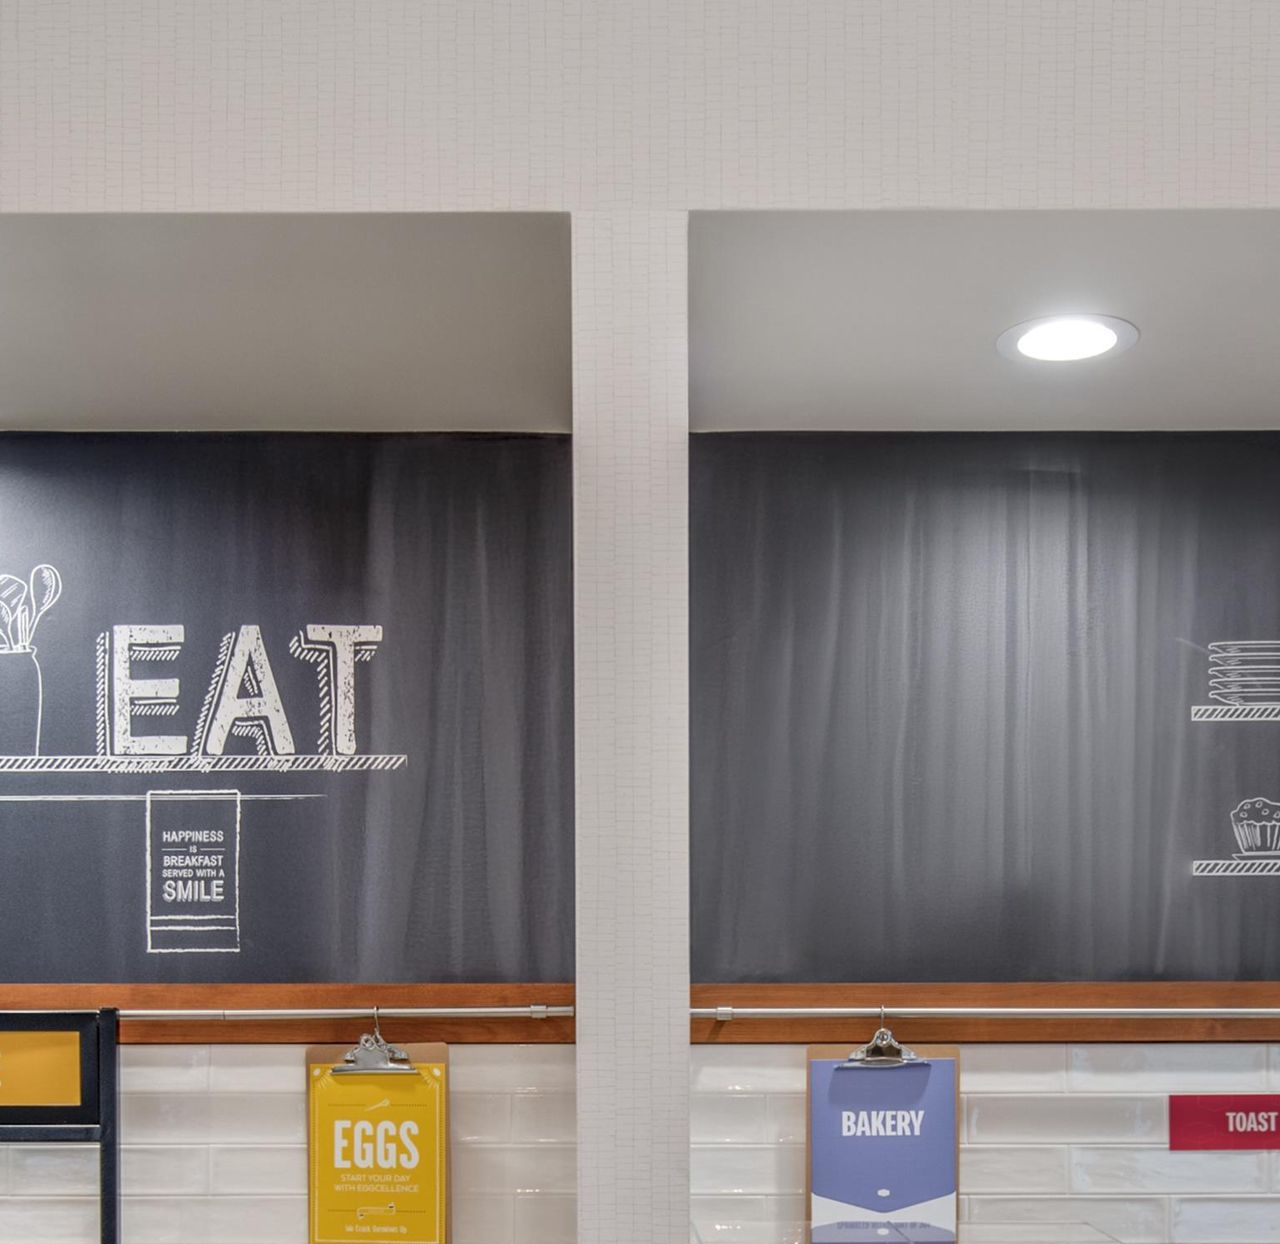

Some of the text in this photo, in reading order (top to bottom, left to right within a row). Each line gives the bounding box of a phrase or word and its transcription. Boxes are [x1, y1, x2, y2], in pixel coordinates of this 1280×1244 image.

[97, 625, 383, 757] EAT
[162, 831, 224, 842] HAPPINESS
[189, 845, 197, 853] IS
[163, 855, 223, 867] BREAKFAST
[162, 869, 225, 877] SERVED WITH A
[162, 880, 224, 902] SMILE
[841, 1110, 924, 1137] BAKERY
[1226, 1112, 1278, 1132] TOAST
[333, 1120, 420, 1169] EGGS
[341, 1174, 410, 1182] START YOUR DAY
[334, 1184, 356, 1192] WITH
